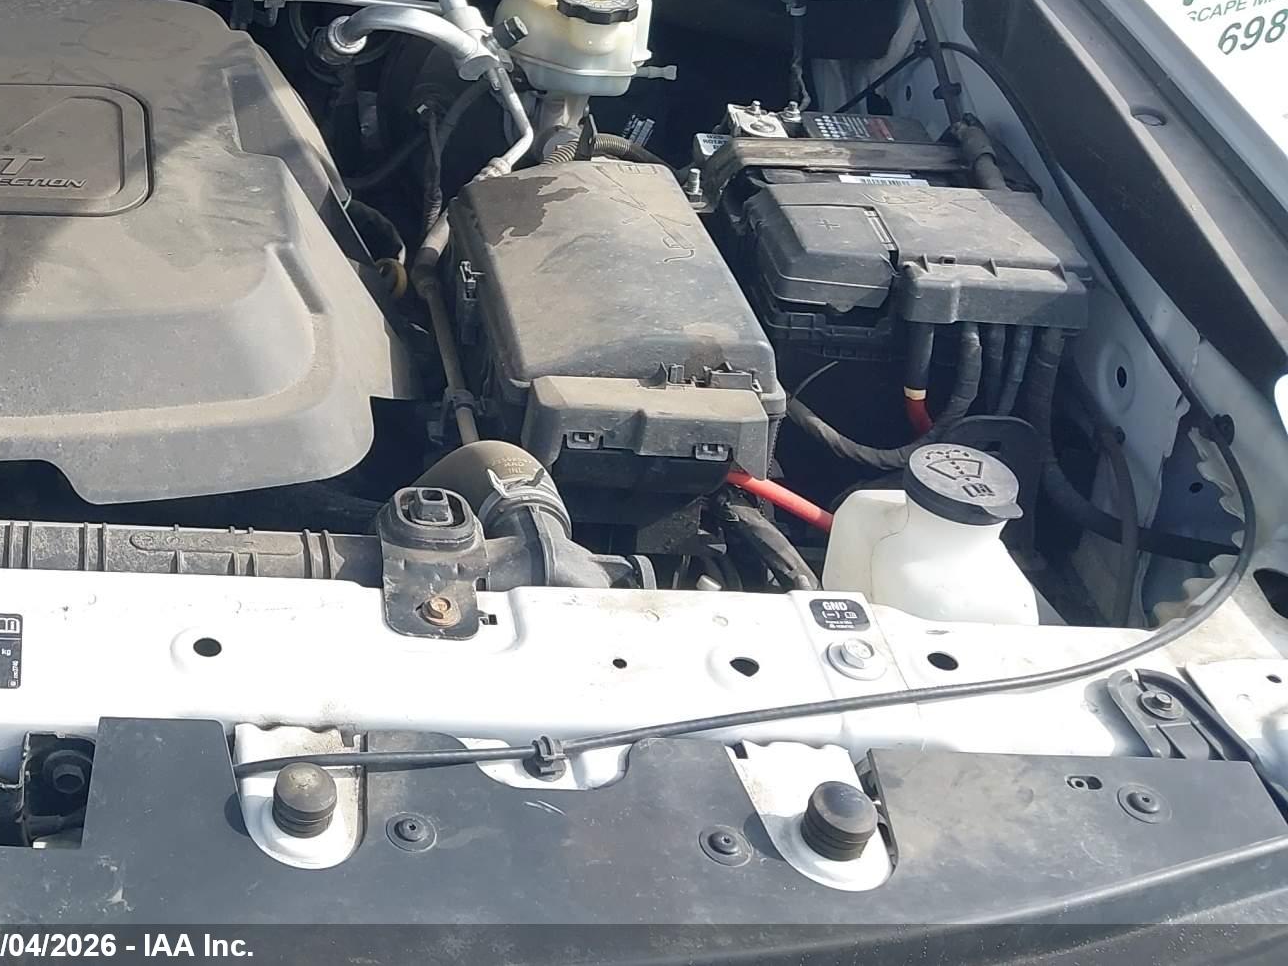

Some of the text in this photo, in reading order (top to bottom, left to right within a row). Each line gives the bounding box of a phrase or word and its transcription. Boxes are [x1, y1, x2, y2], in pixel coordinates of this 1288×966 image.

[1217, 8, 1288, 56] 698
[822, 601, 848, 611] GND
[1, 648, 12, 656] kg
